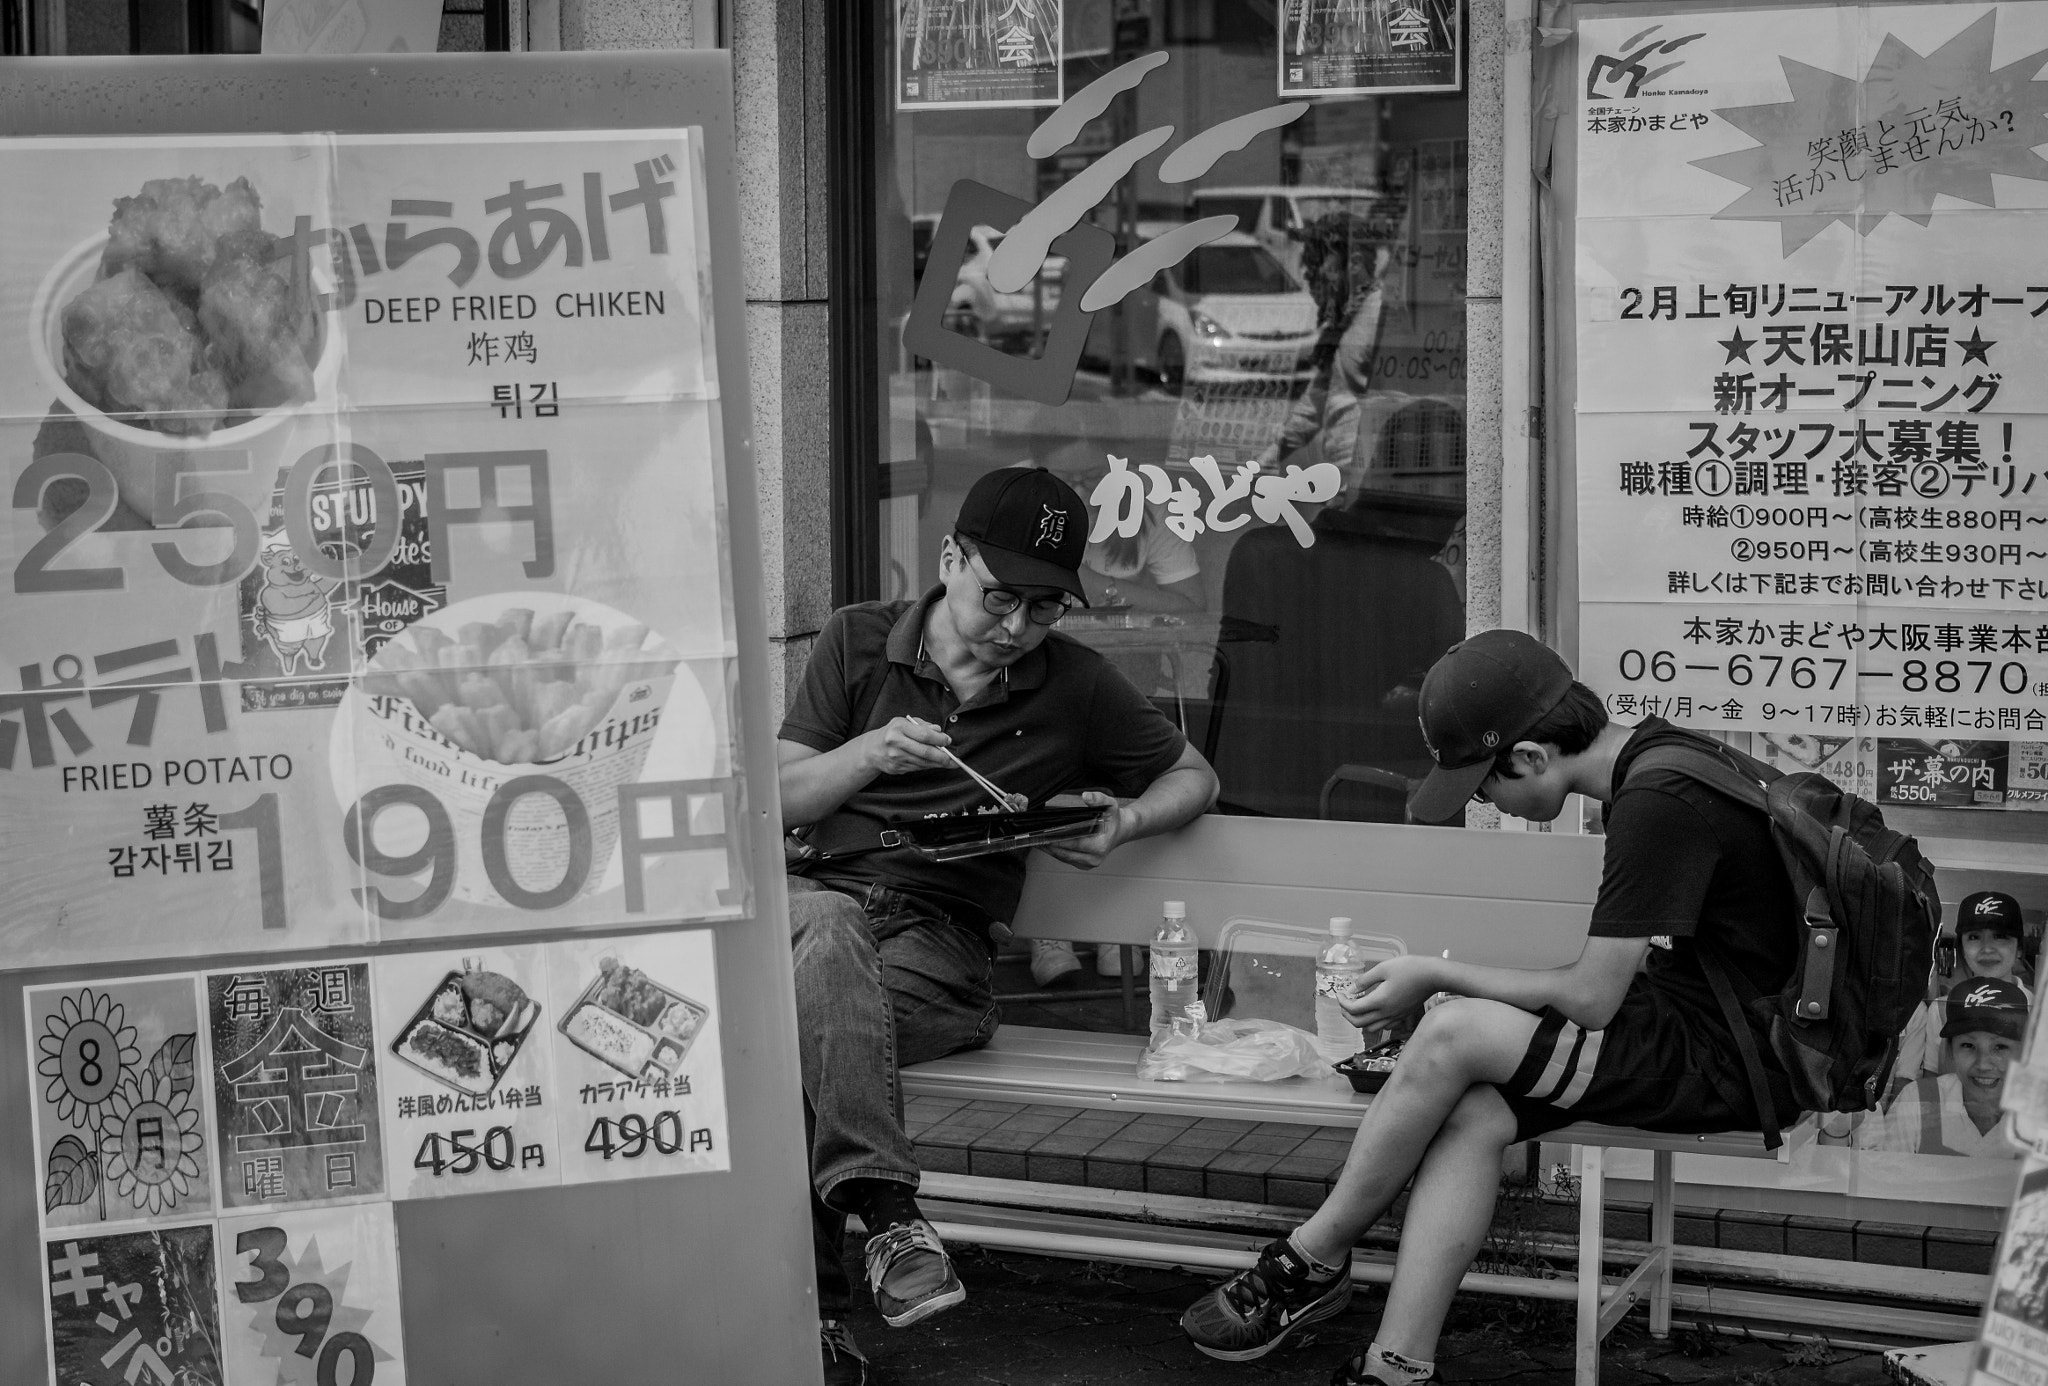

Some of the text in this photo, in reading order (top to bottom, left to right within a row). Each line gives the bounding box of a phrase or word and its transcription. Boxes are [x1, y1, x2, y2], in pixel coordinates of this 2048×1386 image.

[1587, 113, 1709, 134] 本家かまどや
[1807, 96, 1969, 166] 笑顔と元気
[274, 153, 677, 313] からあげ
[365, 290, 666, 324] DEEP FRIED CHIKEN
[467, 330, 537, 367] 炸鸡
[491, 382, 559, 419] 튀김
[1713, 370, 2003, 416] 新オープニング
[13, 442, 559, 595] 250円
[1089, 454, 1341, 548] かまどや
[363, 591, 419, 618] House
[384, 621, 399, 631] OF
[0, 632, 243, 771] ポテト
[62, 753, 294, 793] FRIED POTATO
[144, 801, 221, 841] 薯条
[108, 839, 235, 878] 감자튀김
[398, 1085, 543, 1119] 洋風めんたい弁当
[580, 1075, 692, 1104] カラアゲ弁当
